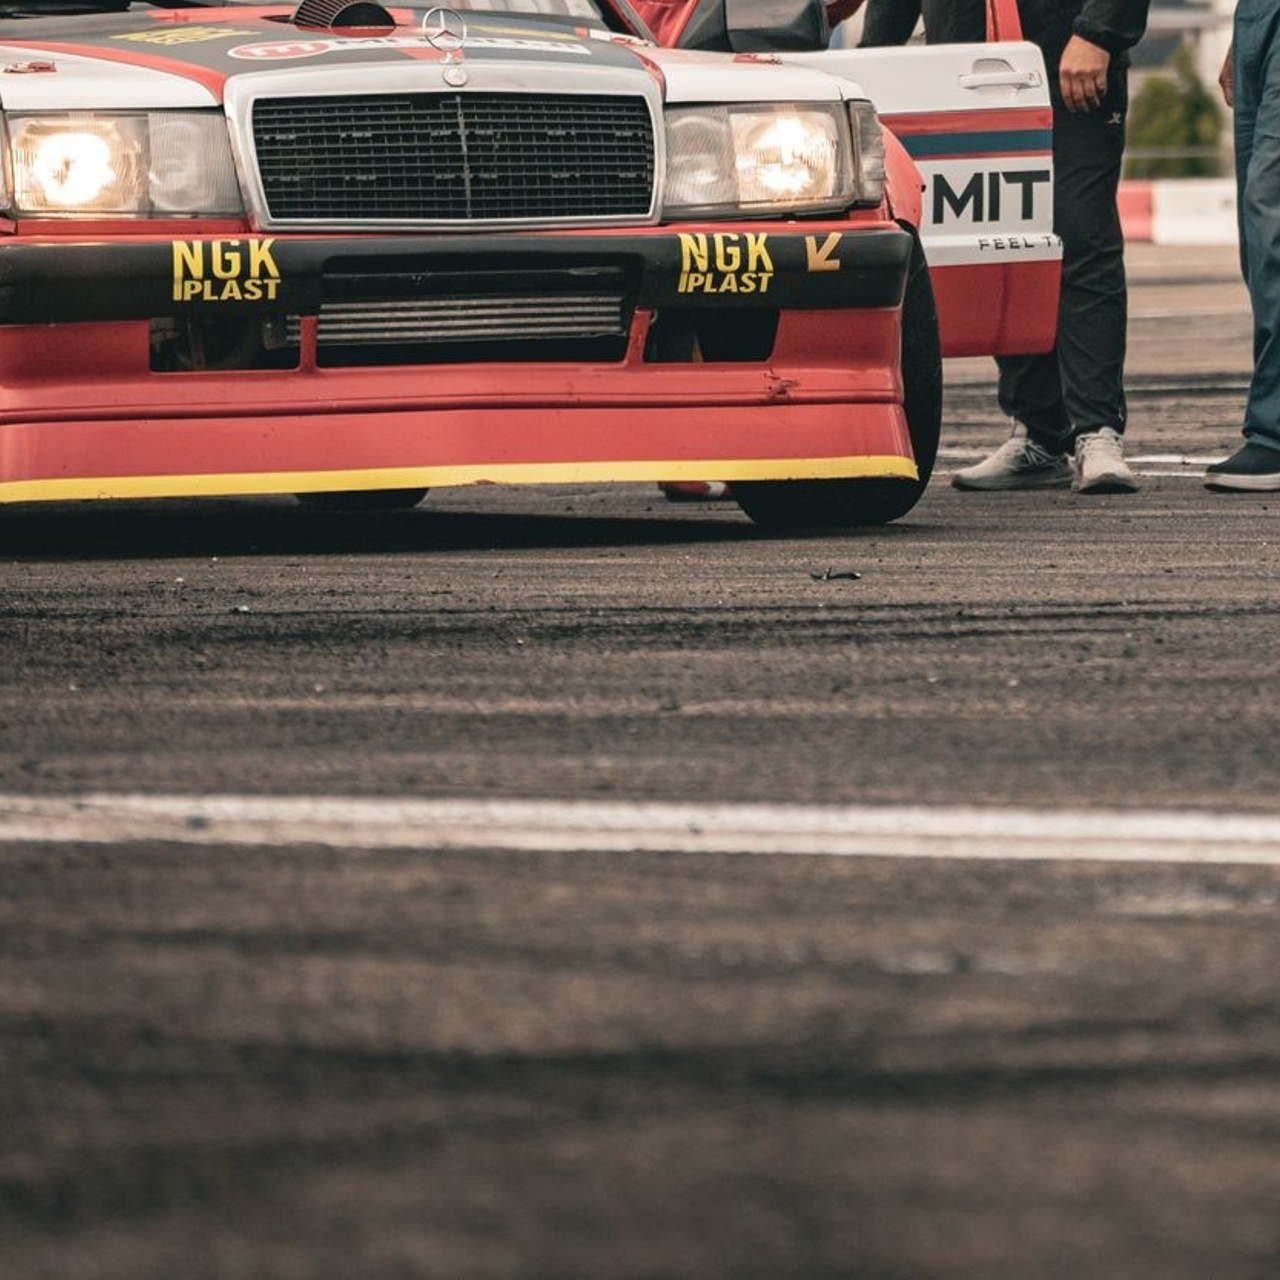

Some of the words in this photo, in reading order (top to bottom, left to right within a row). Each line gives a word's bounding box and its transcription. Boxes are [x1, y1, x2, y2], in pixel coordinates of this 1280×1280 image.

[172, 238, 280, 280] NGK
[677, 232, 774, 273] NGK
[978, 236, 1034, 251] FEEL
